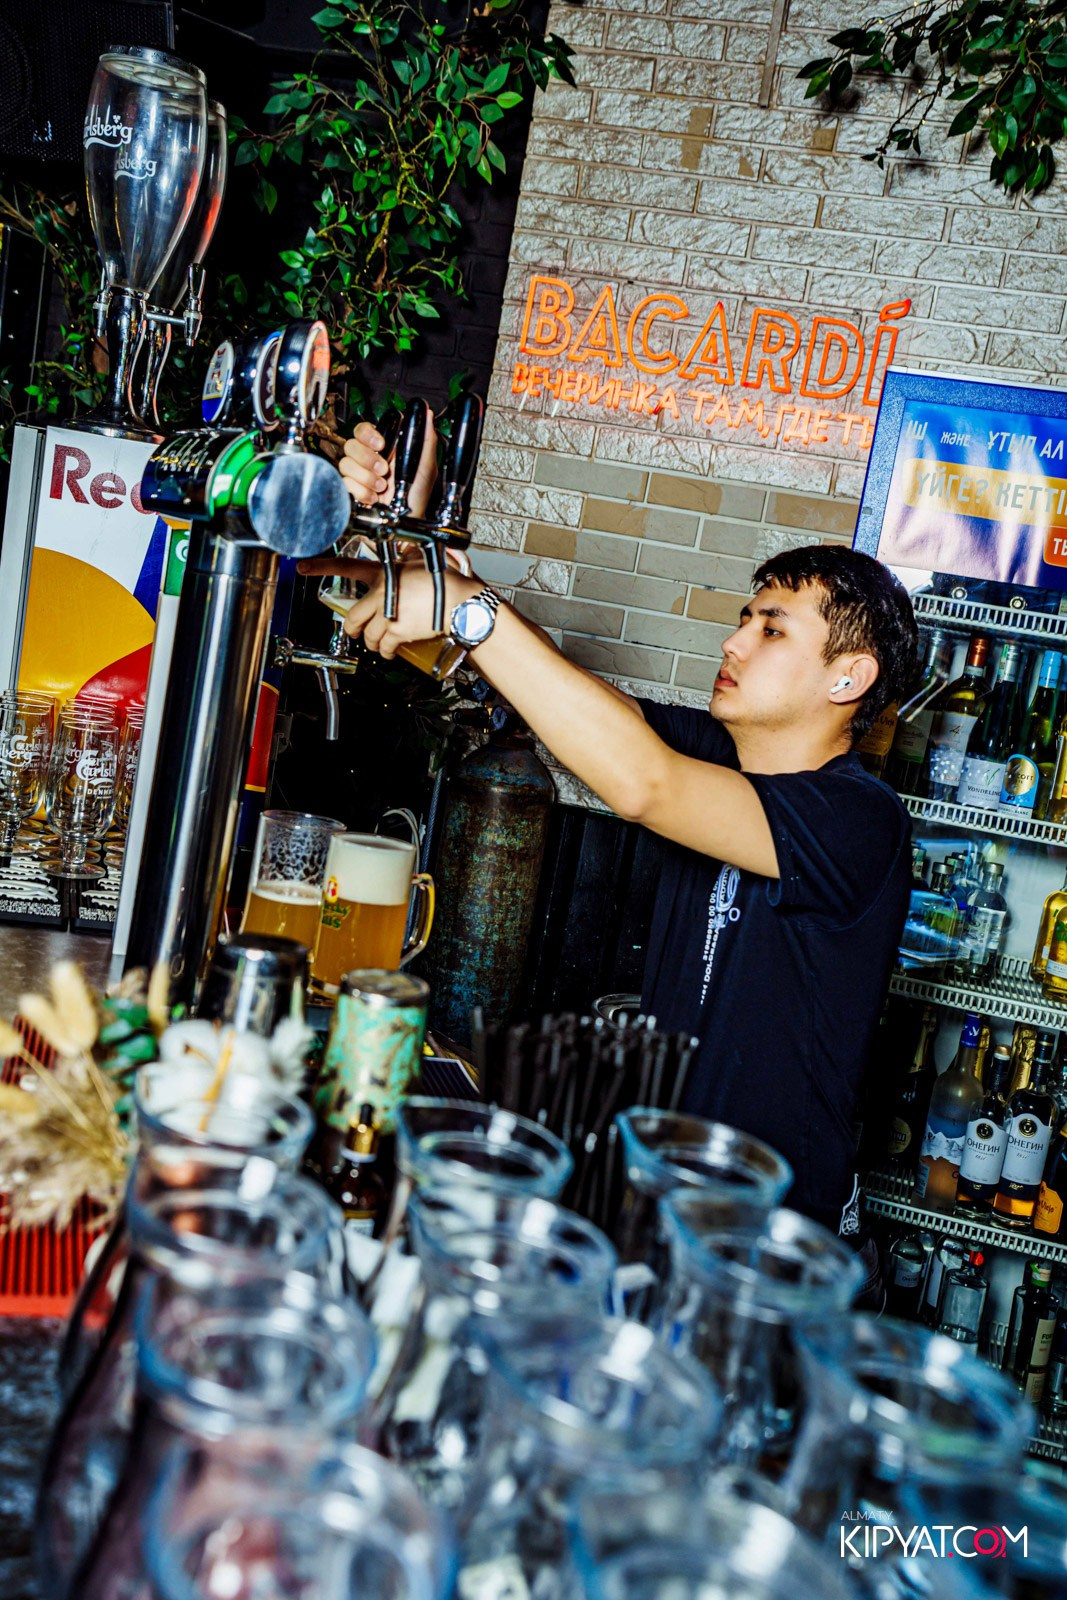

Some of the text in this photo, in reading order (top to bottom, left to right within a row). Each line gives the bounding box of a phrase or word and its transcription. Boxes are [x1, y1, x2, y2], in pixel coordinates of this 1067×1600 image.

[520, 275, 912, 407] BACARDÍ
[512, 362, 680, 419] ВЕЧЕРИНКА
[996, 481, 1067, 516] КЕТТІ
[967, 1137, 1000, 1154] ОНЕГИН
[1007, 1134, 1044, 1151] ОНЕГИН
